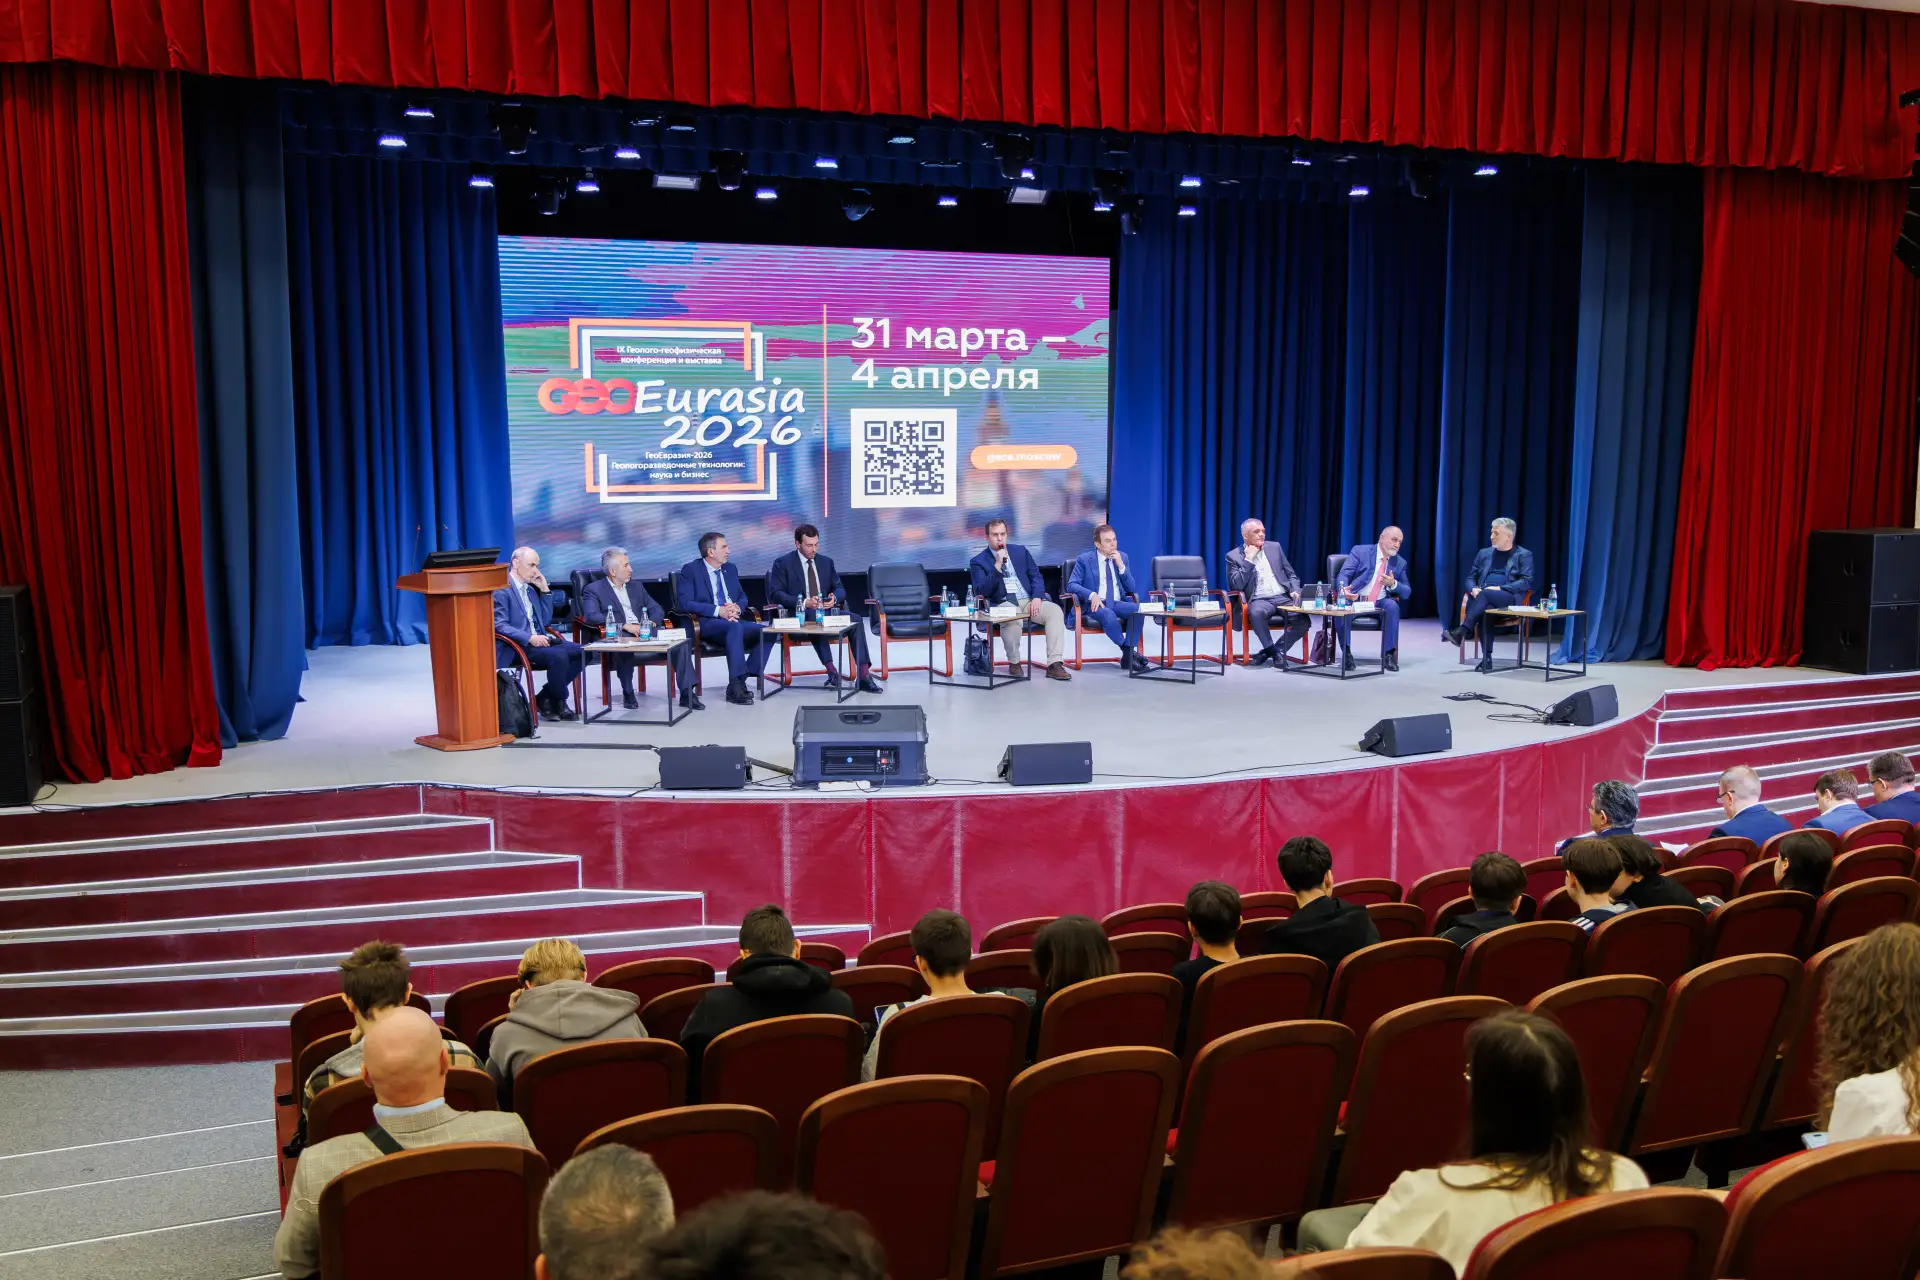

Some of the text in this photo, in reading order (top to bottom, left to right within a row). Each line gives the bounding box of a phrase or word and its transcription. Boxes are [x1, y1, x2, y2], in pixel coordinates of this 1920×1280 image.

[852, 317, 890, 348] 31
[905, 327, 1029, 358] марта
[627, 346, 722, 355] Геолого-геофизическая
[621, 356, 676, 365] конференция
[852, 358, 1040, 397] 4 апреля
[660, 415, 802, 448] 2026
[645, 451, 713, 460] ГеоЕвразия-2026
[611, 462, 696, 470] Геологоразведочные
